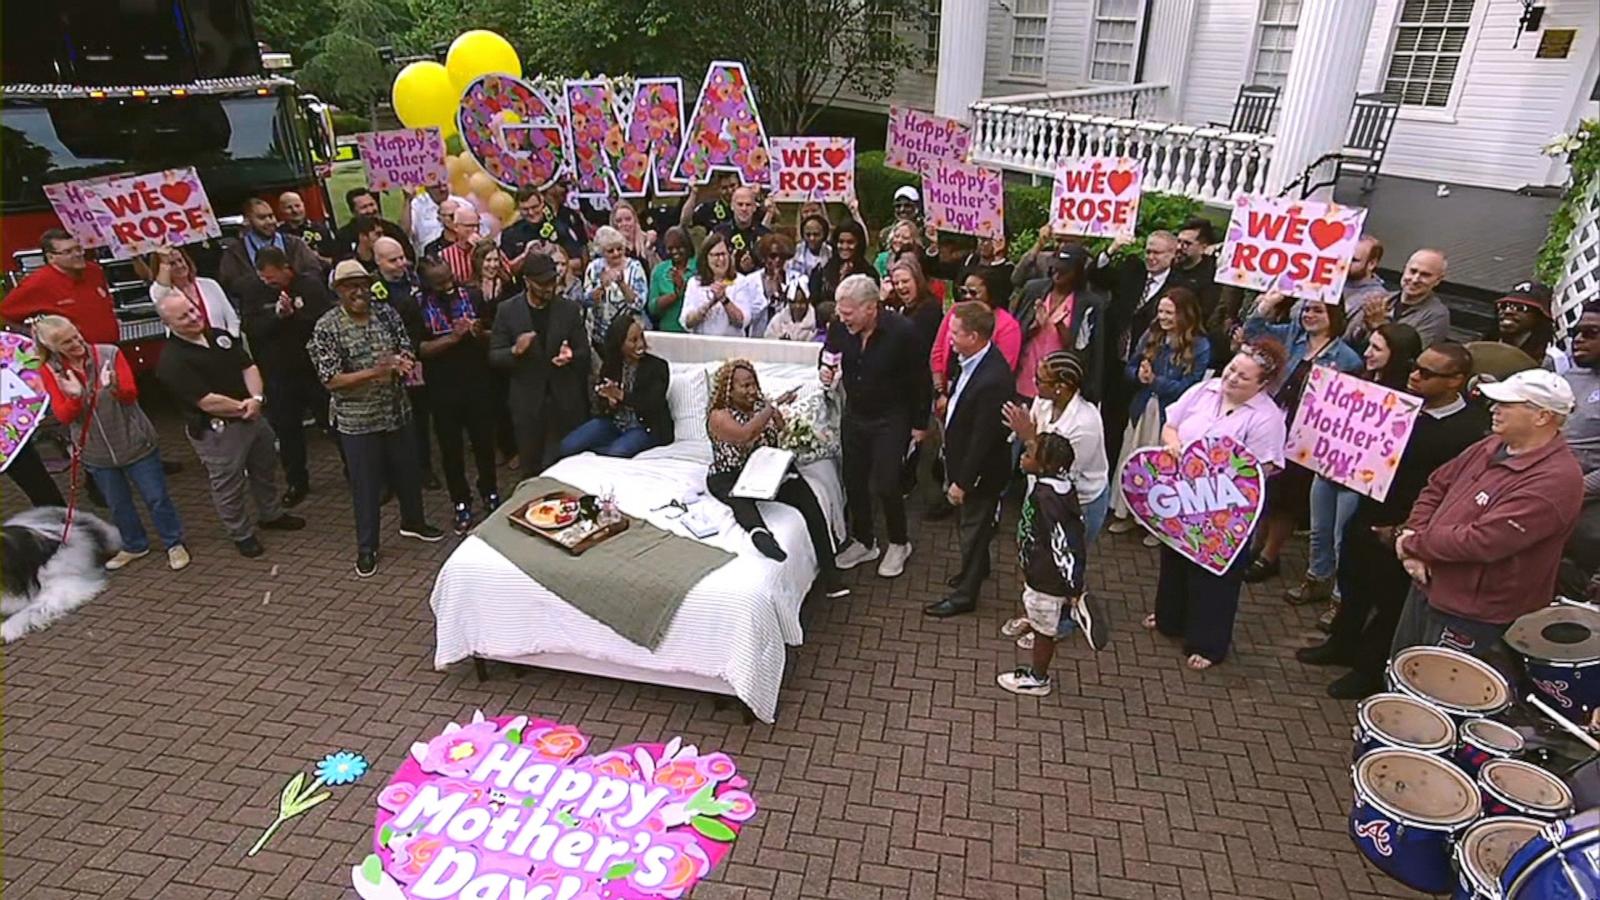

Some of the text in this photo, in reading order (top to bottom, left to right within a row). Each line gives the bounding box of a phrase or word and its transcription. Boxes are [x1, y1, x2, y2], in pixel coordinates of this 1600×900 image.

[374, 134, 424, 151] Happy
[457, 61, 772, 198] GMA
[905, 115, 953, 143] Happy
[781, 149, 822, 168] WE
[893, 131, 961, 159] Mother's
[368, 151, 438, 170] Mother's
[388, 166, 425, 184] Day!
[779, 172, 847, 191] ROSE
[937, 166, 986, 192] Happy
[1066, 170, 1107, 194] WE
[102, 187, 165, 218] WE
[930, 186, 996, 210] Mother's
[1058, 197, 1130, 224] ROSE
[112, 206, 207, 245] ROSE
[945, 207, 979, 230] Day!
[1248, 211, 1309, 245] WE
[1231, 242, 1338, 285] ROSE
[1323, 381, 1392, 428] Happy
[1303, 405, 1394, 457] Mother's
[1313, 436, 1362, 476] Day!
[1148, 473, 1250, 518] GMA
[469, 743, 670, 828] Happy
[394, 784, 676, 887] Mother's
